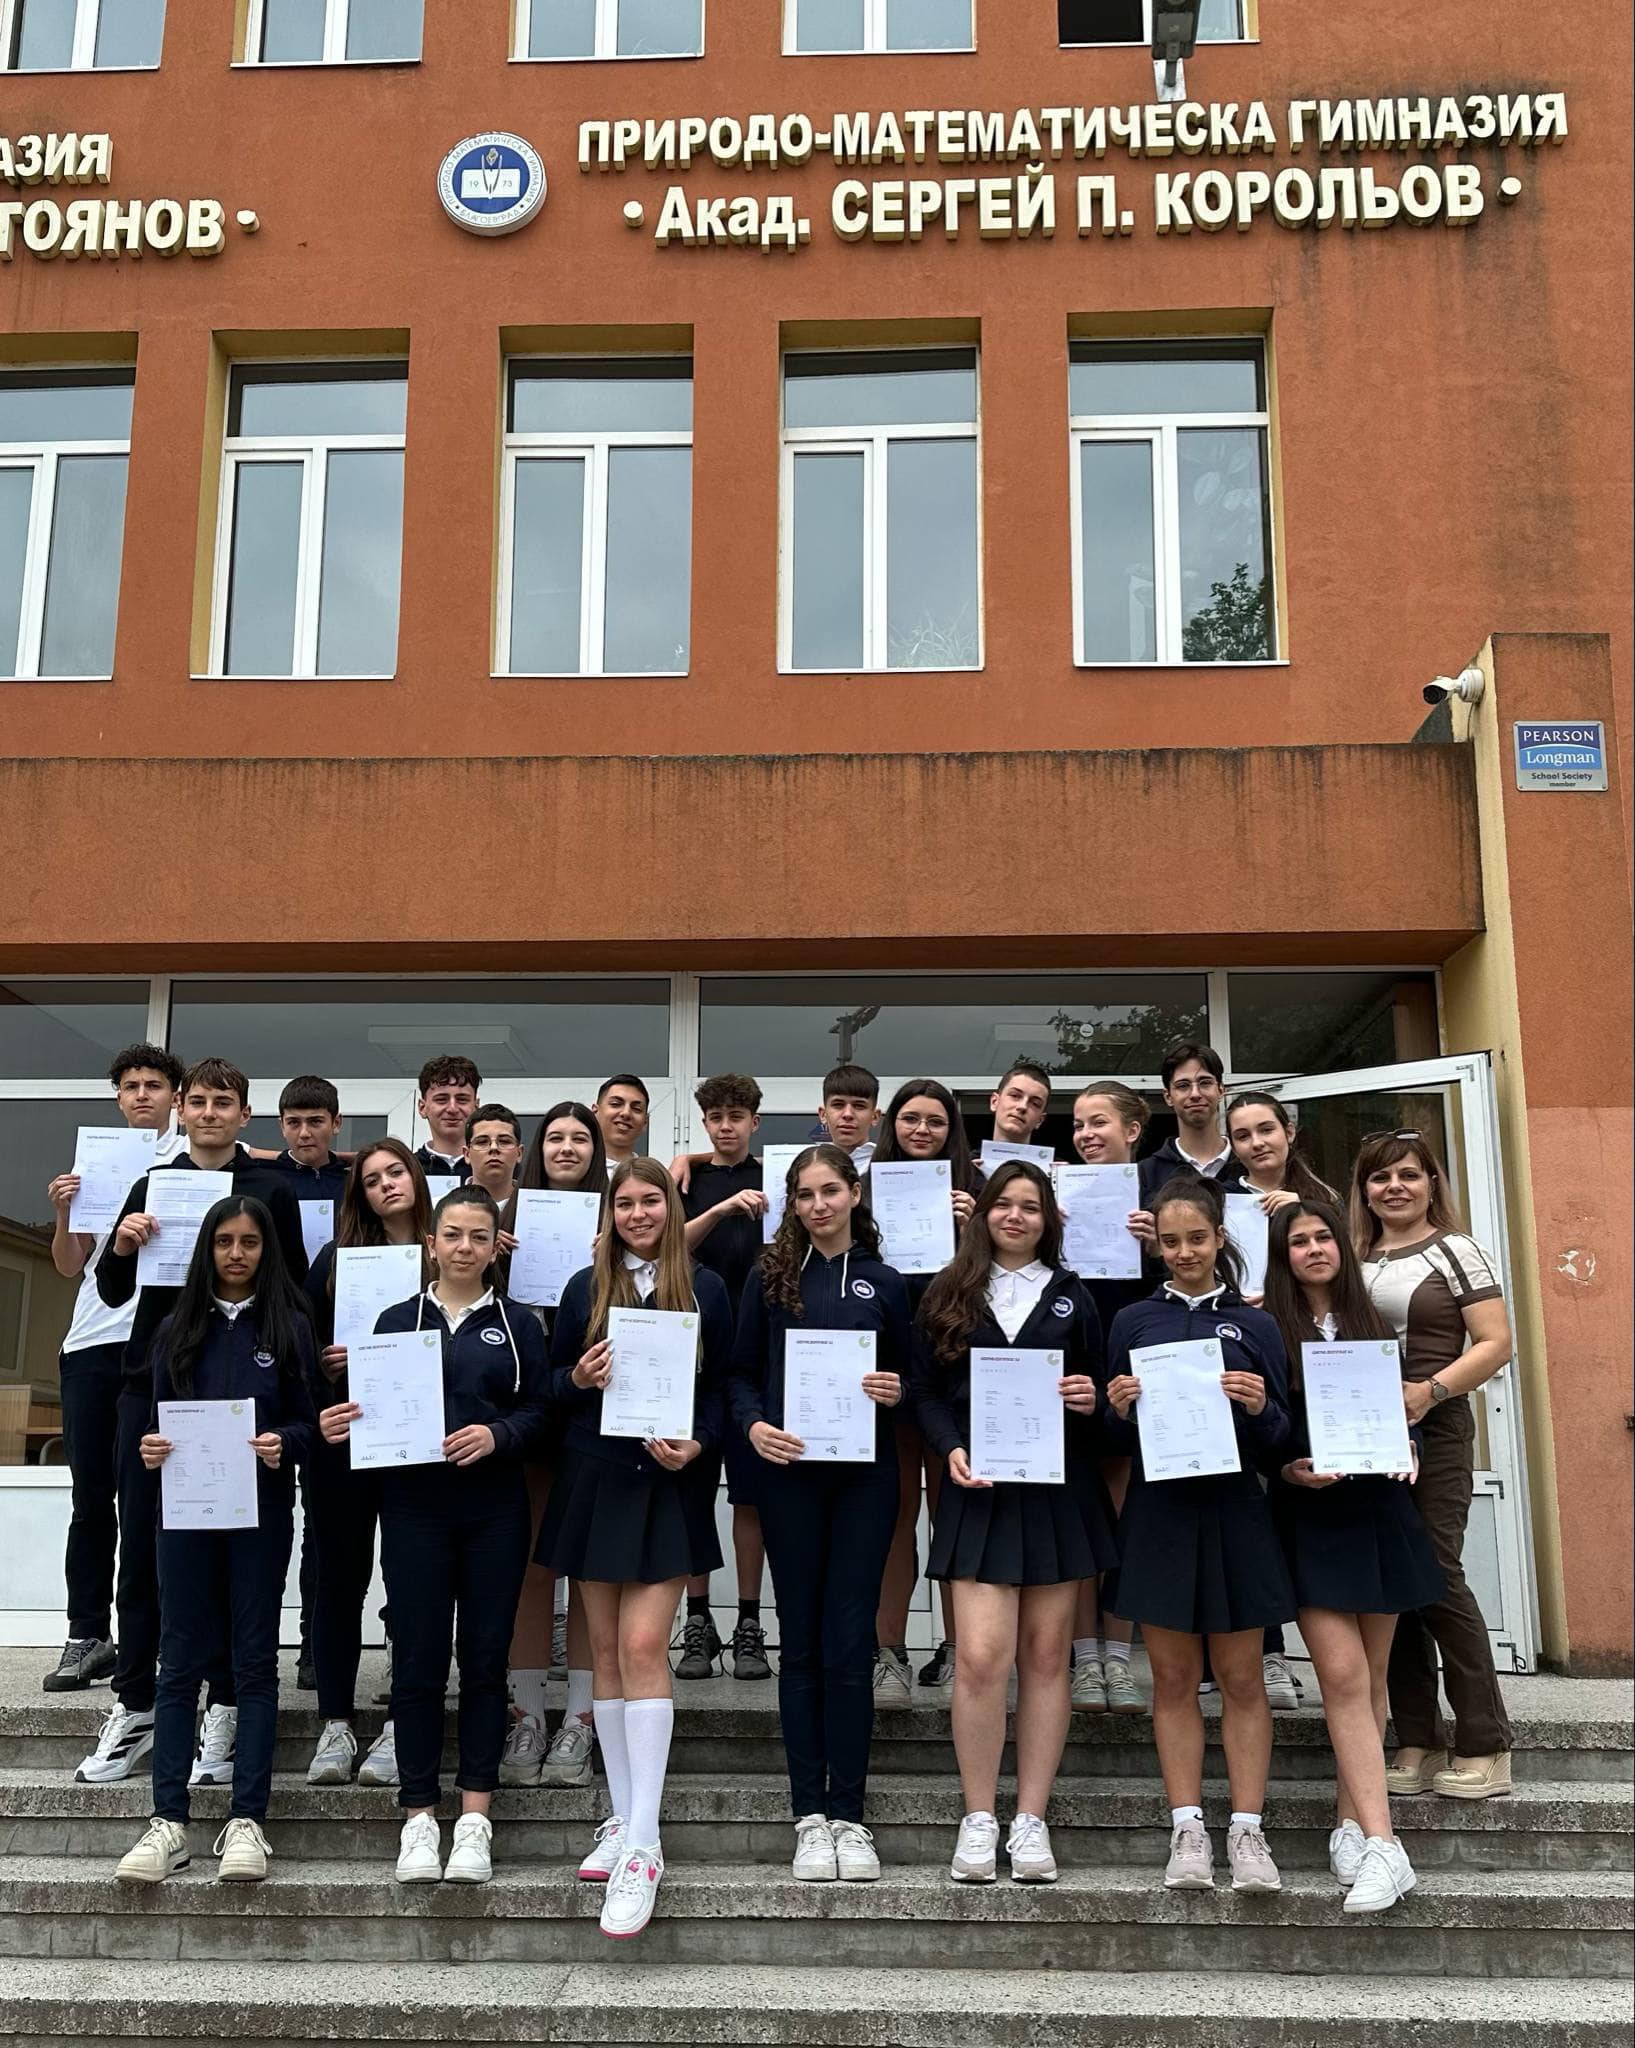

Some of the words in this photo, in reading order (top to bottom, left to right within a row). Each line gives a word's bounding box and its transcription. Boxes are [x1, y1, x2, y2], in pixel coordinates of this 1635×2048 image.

[578, 101, 1277, 170] ПРИРОДО-МАТЕМАТИЧЕСКА
[1288, 92, 1568, 152] ГИМНАЗИЯ
[655, 186, 811, 253] Акад.
[832, 162, 1056, 240] СЕРГЕЙ
[1077, 174, 1134, 236] П.
[1155, 164, 1484, 234] КОРОЛЬОВ
[1523, 730, 1594, 742] PEARSON
[1526, 750, 1595, 766] Longman
[1531, 771, 1560, 780] School
[1562, 771, 1593, 782] Society
